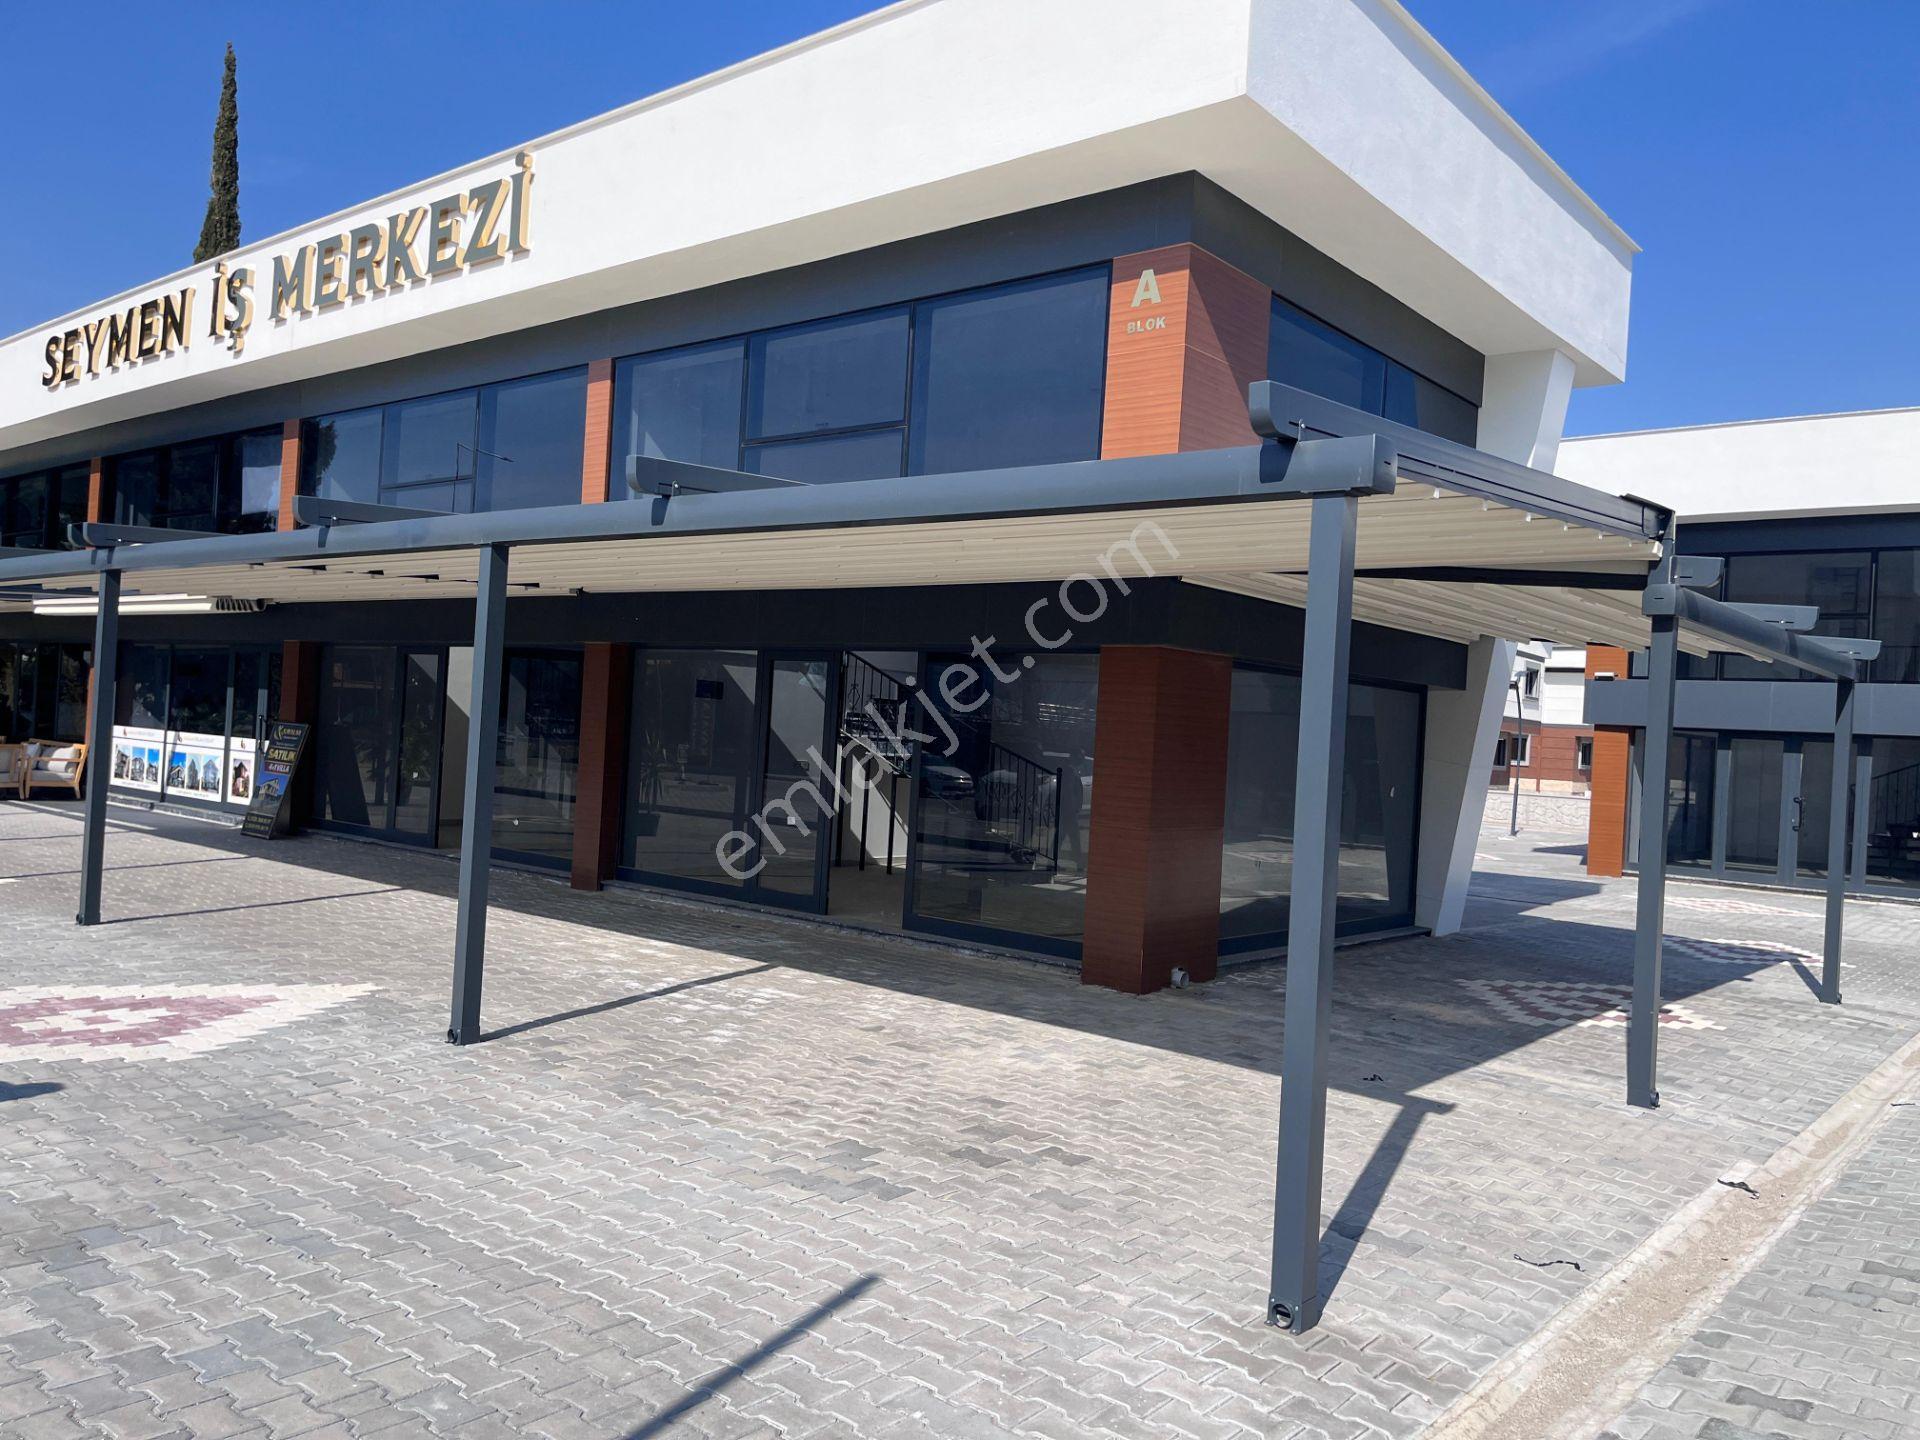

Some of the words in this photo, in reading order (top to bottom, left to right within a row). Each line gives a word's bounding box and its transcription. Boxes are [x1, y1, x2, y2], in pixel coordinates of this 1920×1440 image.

[42, 287, 195, 387] SEYMEN
[208, 262, 256, 352] İŞ
[268, 150, 535, 321] MERKEZİ
[1130, 268, 1161, 308] A
[1127, 316, 1167, 334] BLOK
